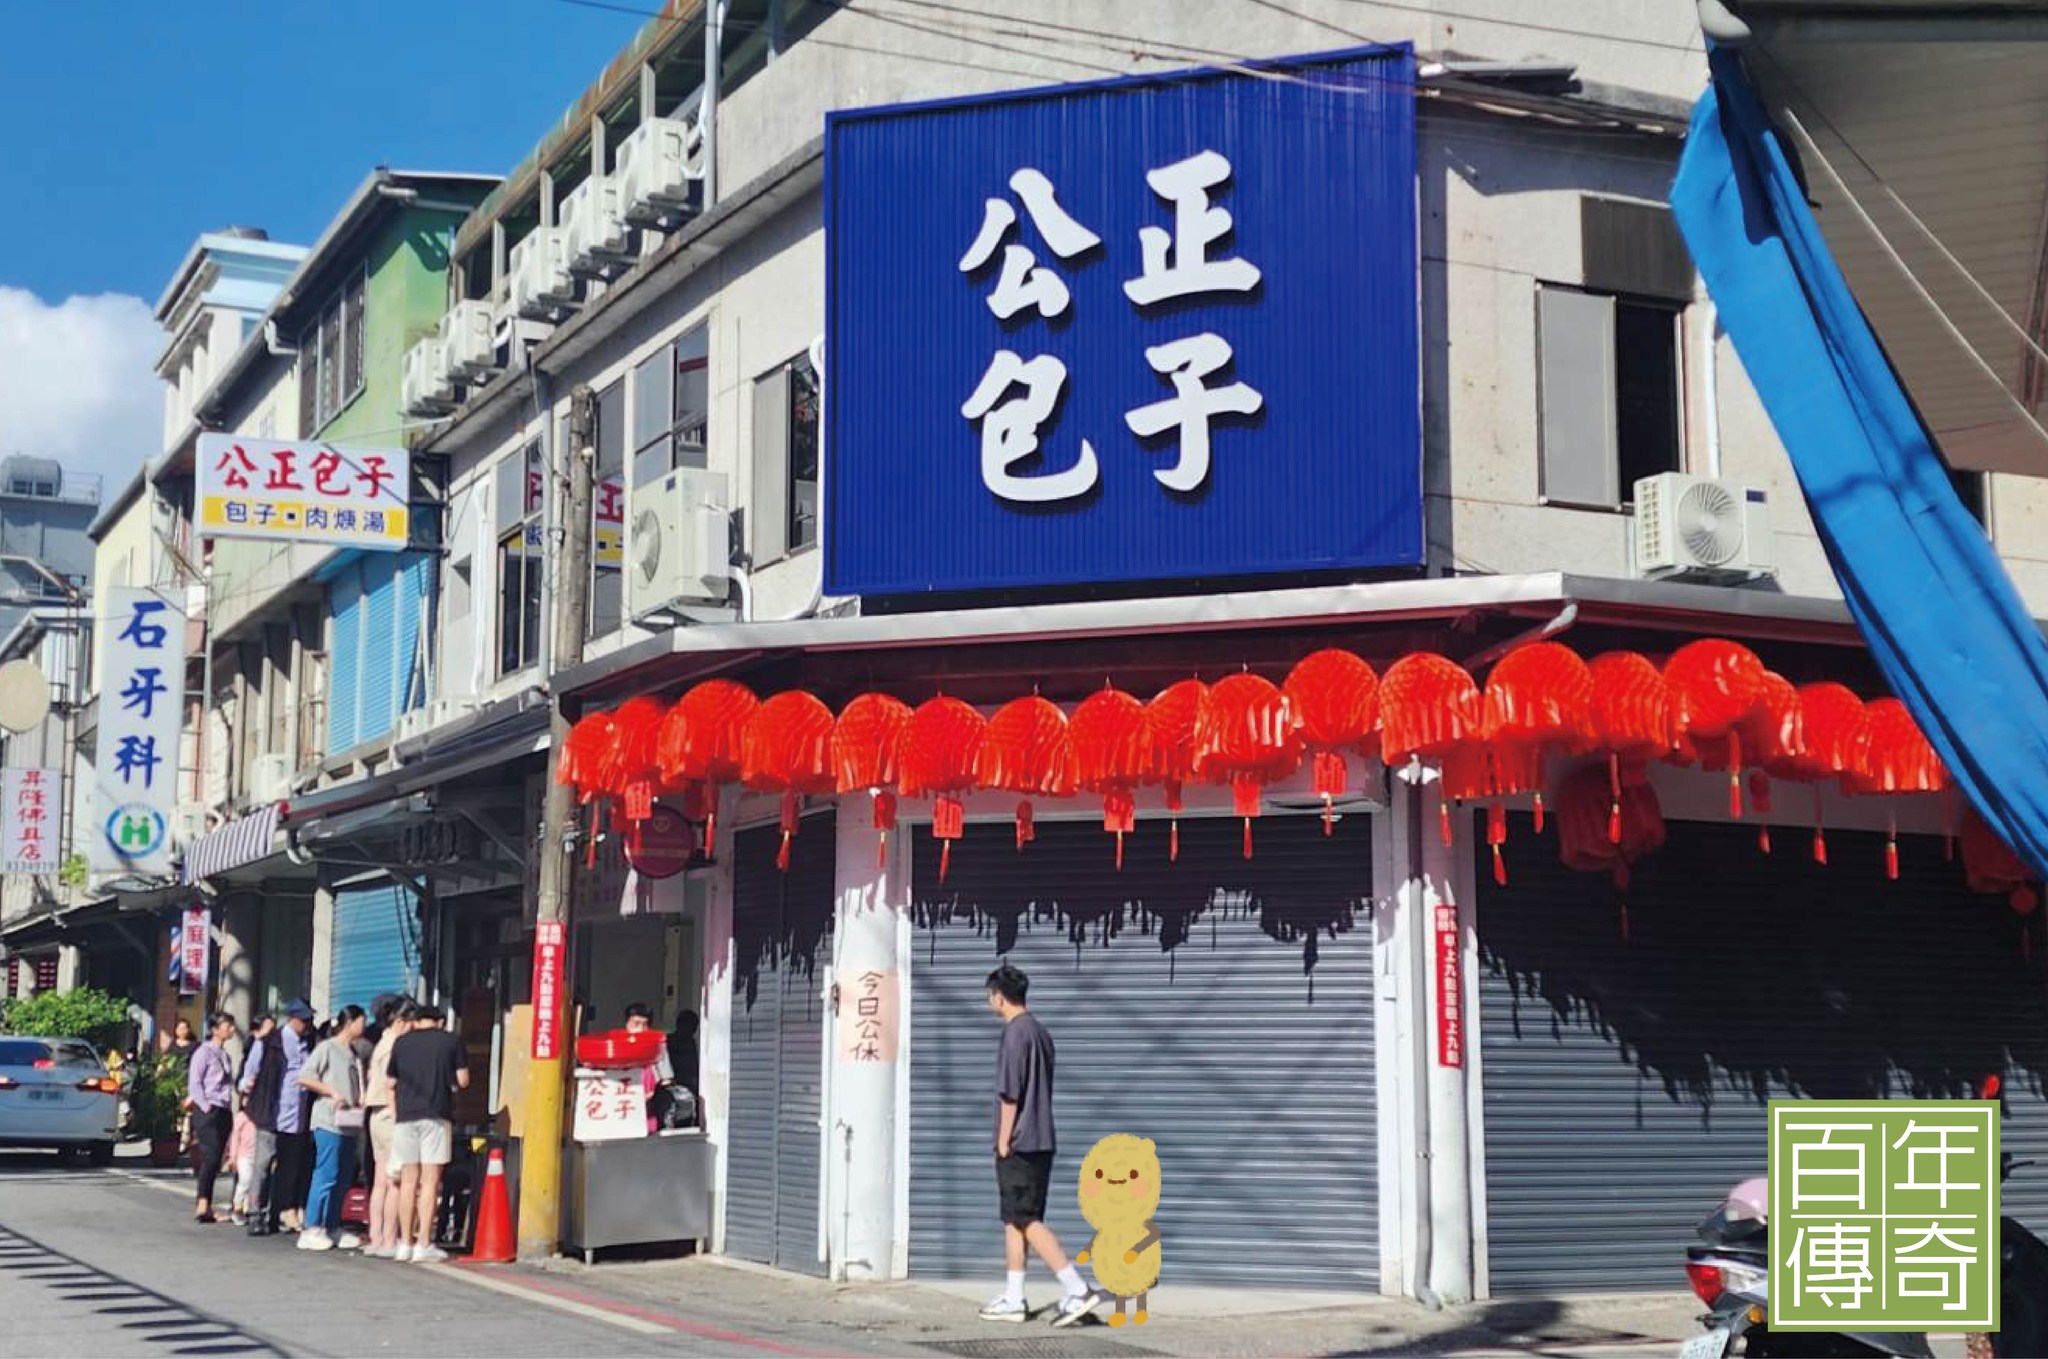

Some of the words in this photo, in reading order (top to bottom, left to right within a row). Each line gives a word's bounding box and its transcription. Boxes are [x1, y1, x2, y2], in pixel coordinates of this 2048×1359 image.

[959, 149, 1262, 319] 公正
[960, 332, 1263, 502] 包子
[215, 444, 395, 499] 公正包子
[114, 600, 168, 789] 石牙科
[848, 971, 884, 1062] 今日公休
[583, 1076, 637, 1096] 公正
[584, 1099, 637, 1121] 包子
